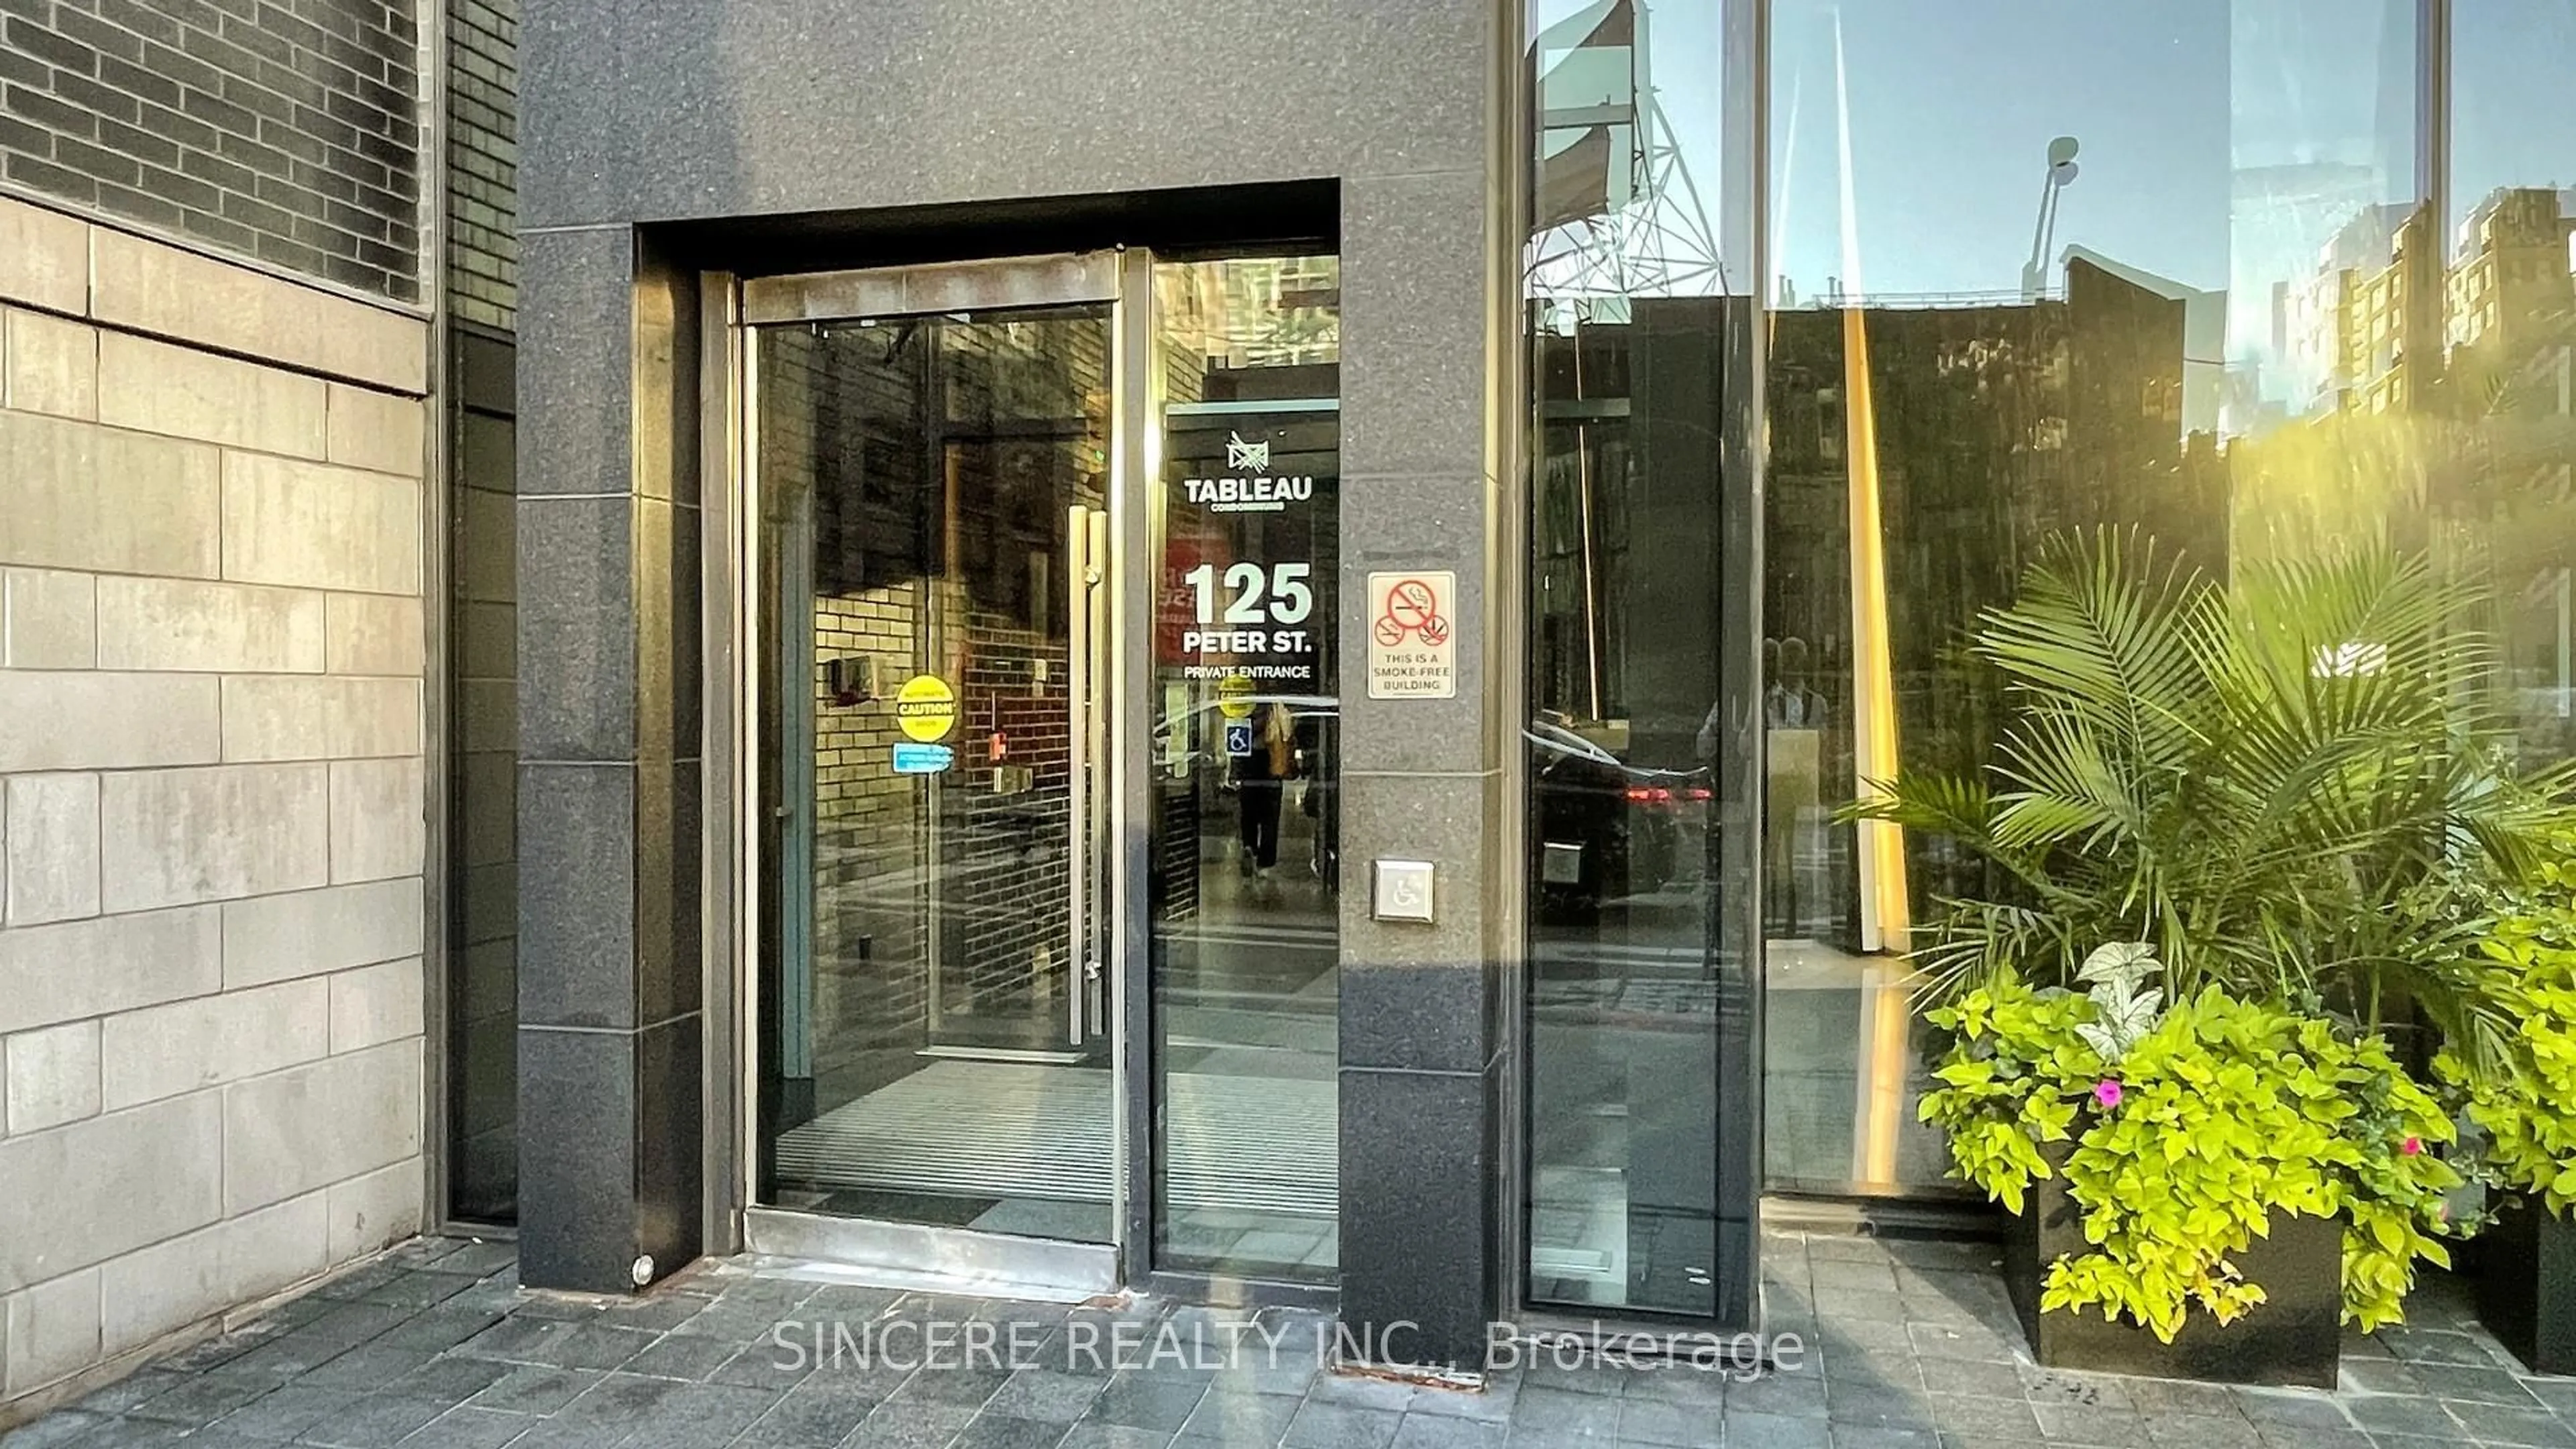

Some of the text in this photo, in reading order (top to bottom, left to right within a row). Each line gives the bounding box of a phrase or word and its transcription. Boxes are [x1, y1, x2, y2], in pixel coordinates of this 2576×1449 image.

[1184, 476, 1312, 502] TABLEAU
[1185, 563, 1312, 625] 125
[1183, 631, 1311, 653] PETER ST.
[1385, 655, 1438, 663] THIS IS A
[1184, 666, 1310, 678] PRIVATE ENTRANCE
[1384, 681, 1440, 690] BUILDING
[900, 703, 953, 715] CAUTION
